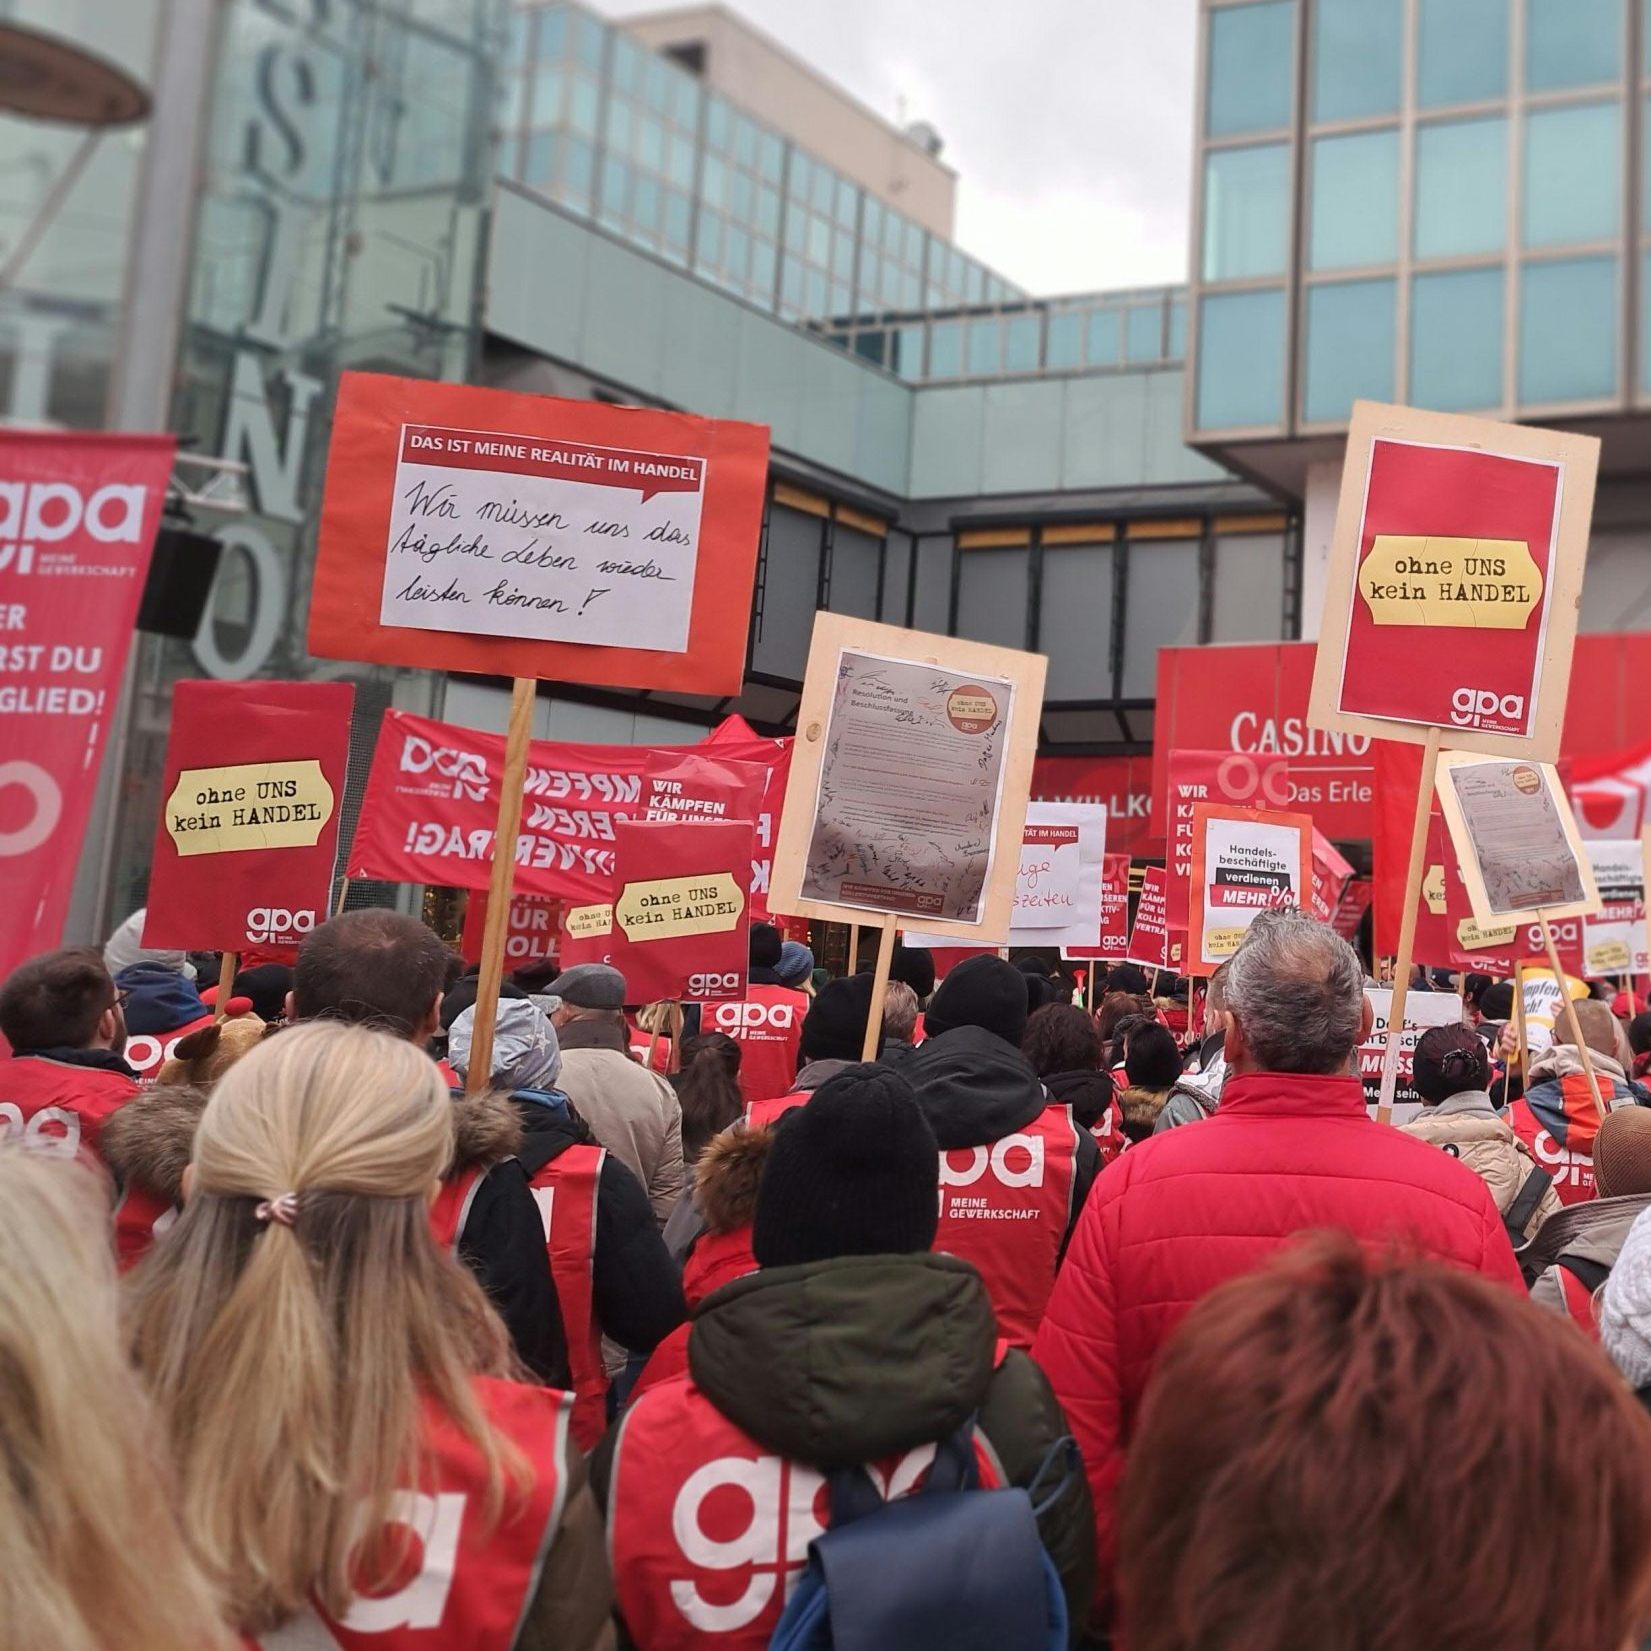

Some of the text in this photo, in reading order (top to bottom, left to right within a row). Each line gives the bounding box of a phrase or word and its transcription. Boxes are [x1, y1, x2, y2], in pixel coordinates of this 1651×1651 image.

[410, 435, 698, 482] DAS IST MEINE REALITÄT IM HANDEL
[405, 481, 691, 546] Wir müssen uns das
[390, 523, 676, 581] tägliche Leben wieder
[1395, 557, 1506, 577] ohne UNS
[396, 575, 472, 604] leisten
[483, 579, 570, 614] können
[1369, 581, 1530, 604] kein HANDEL
[50, 645, 102, 673] DU
[1450, 688, 1524, 727] gpa
[1230, 711, 1372, 757] CASINO
[196, 780, 298, 806] ohne UNS
[653, 779, 683, 795] WIR
[1177, 784, 1208, 799] WIR
[648, 793, 726, 815] KÄMPFEN
[174, 803, 322, 832] kein HANDEL
[1050, 829, 1078, 838] HANDEL
[1229, 844, 1277, 857] Handels-
[1219, 855, 1287, 872] beschäftigte
[1144, 882, 1160, 893] WIR
[1225, 872, 1280, 886] verdienen
[639, 886, 719, 908] ohne UNS
[246, 908, 316, 943] gpa
[624, 901, 737, 927] kein HANDEL
[688, 973, 740, 997] gpa
[949, 1209, 1041, 1220] GEWERKSCHAFT
[950, 1198, 988, 1208] MEINE
